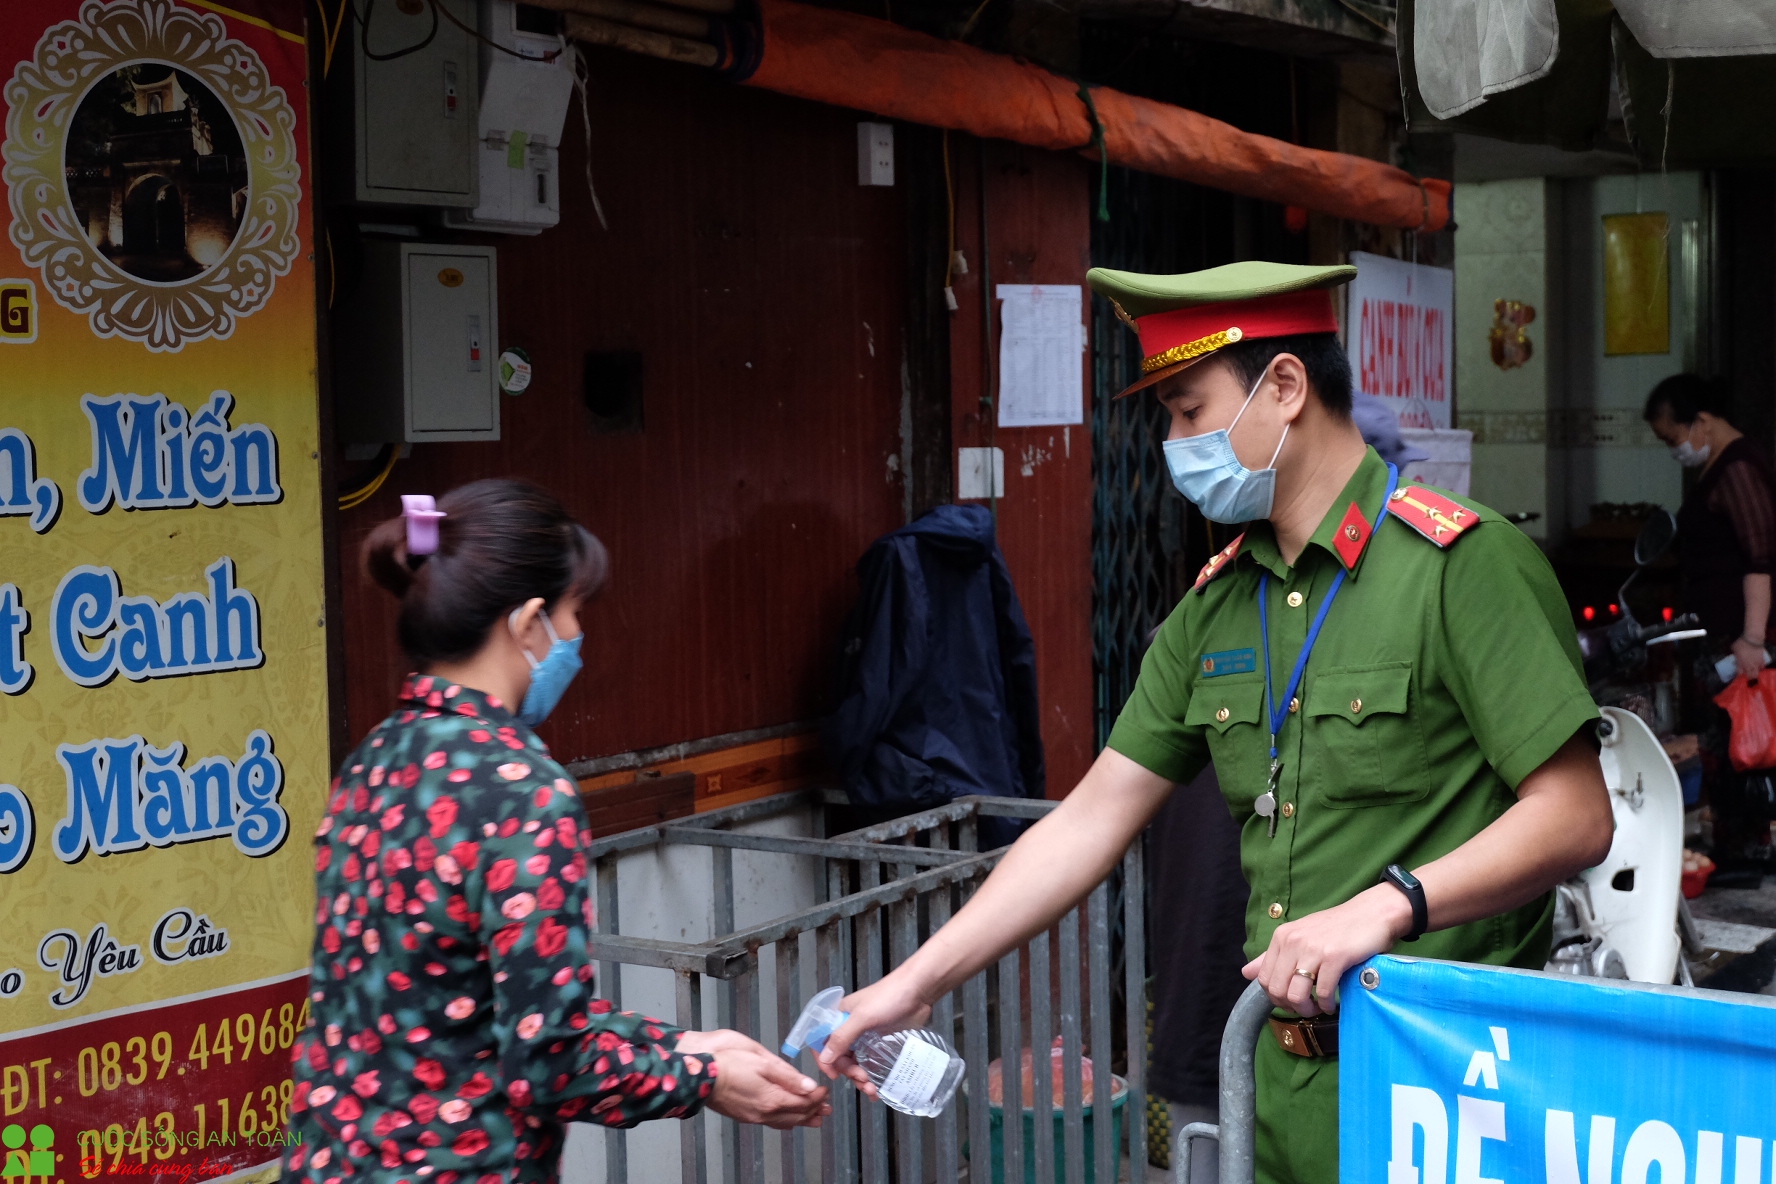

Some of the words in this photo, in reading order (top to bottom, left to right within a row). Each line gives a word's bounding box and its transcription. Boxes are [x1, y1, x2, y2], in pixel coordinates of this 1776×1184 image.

[80, 393, 279, 509] Miến
[53, 560, 260, 683] Canh
[55, 733, 284, 858] Măng
[40, 925, 140, 1006] Yêu
[153, 910, 228, 962] Cầu
[1, 1058, 63, 1117] ĐT:
